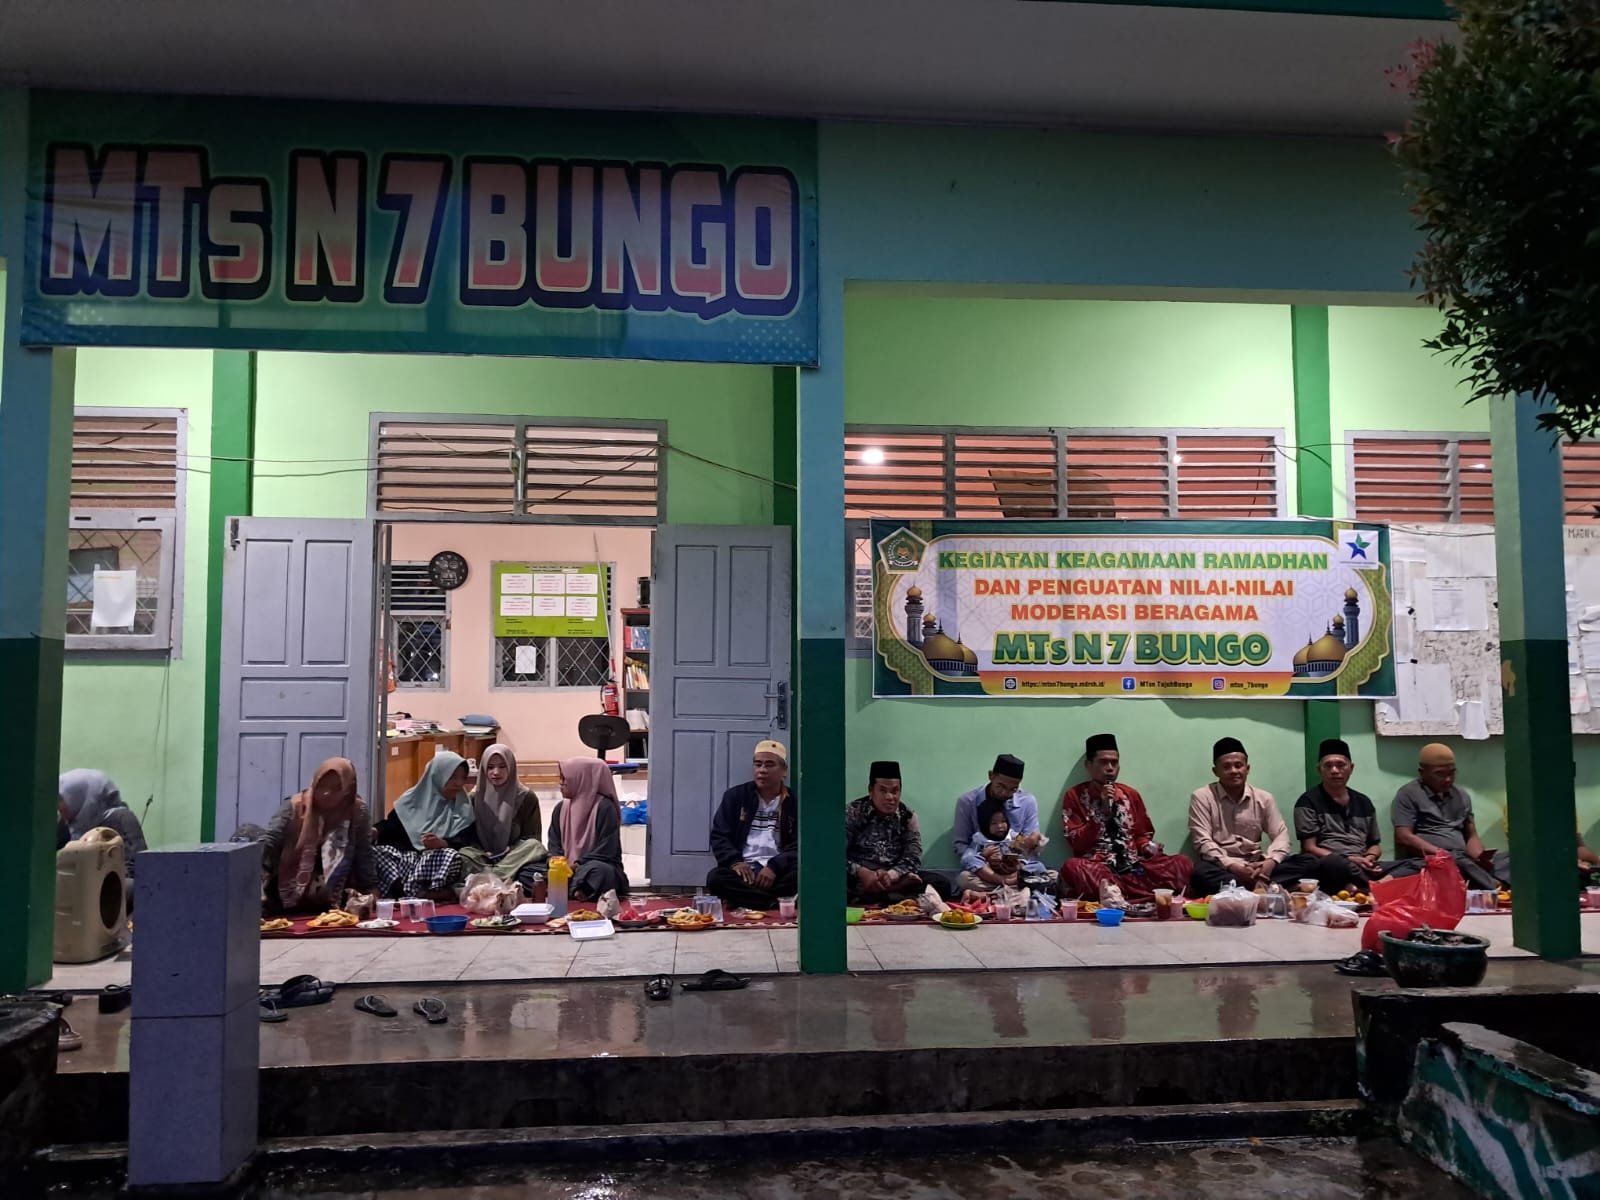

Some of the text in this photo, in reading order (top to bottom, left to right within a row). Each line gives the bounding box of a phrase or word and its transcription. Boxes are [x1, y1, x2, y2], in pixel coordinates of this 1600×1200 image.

[42, 145, 798, 318] MTs N 7 BUNGO
[939, 552, 1328, 570] KEGIATAN KEAGAMAAN RAMADHAN
[975, 579, 1293, 596] DAN PENGUATAN NILAI-NILAI
[1011, 604, 1259, 621] MODERASI BERAGAMA
[992, 632, 1273, 665] MTs N 7 BUNGO
